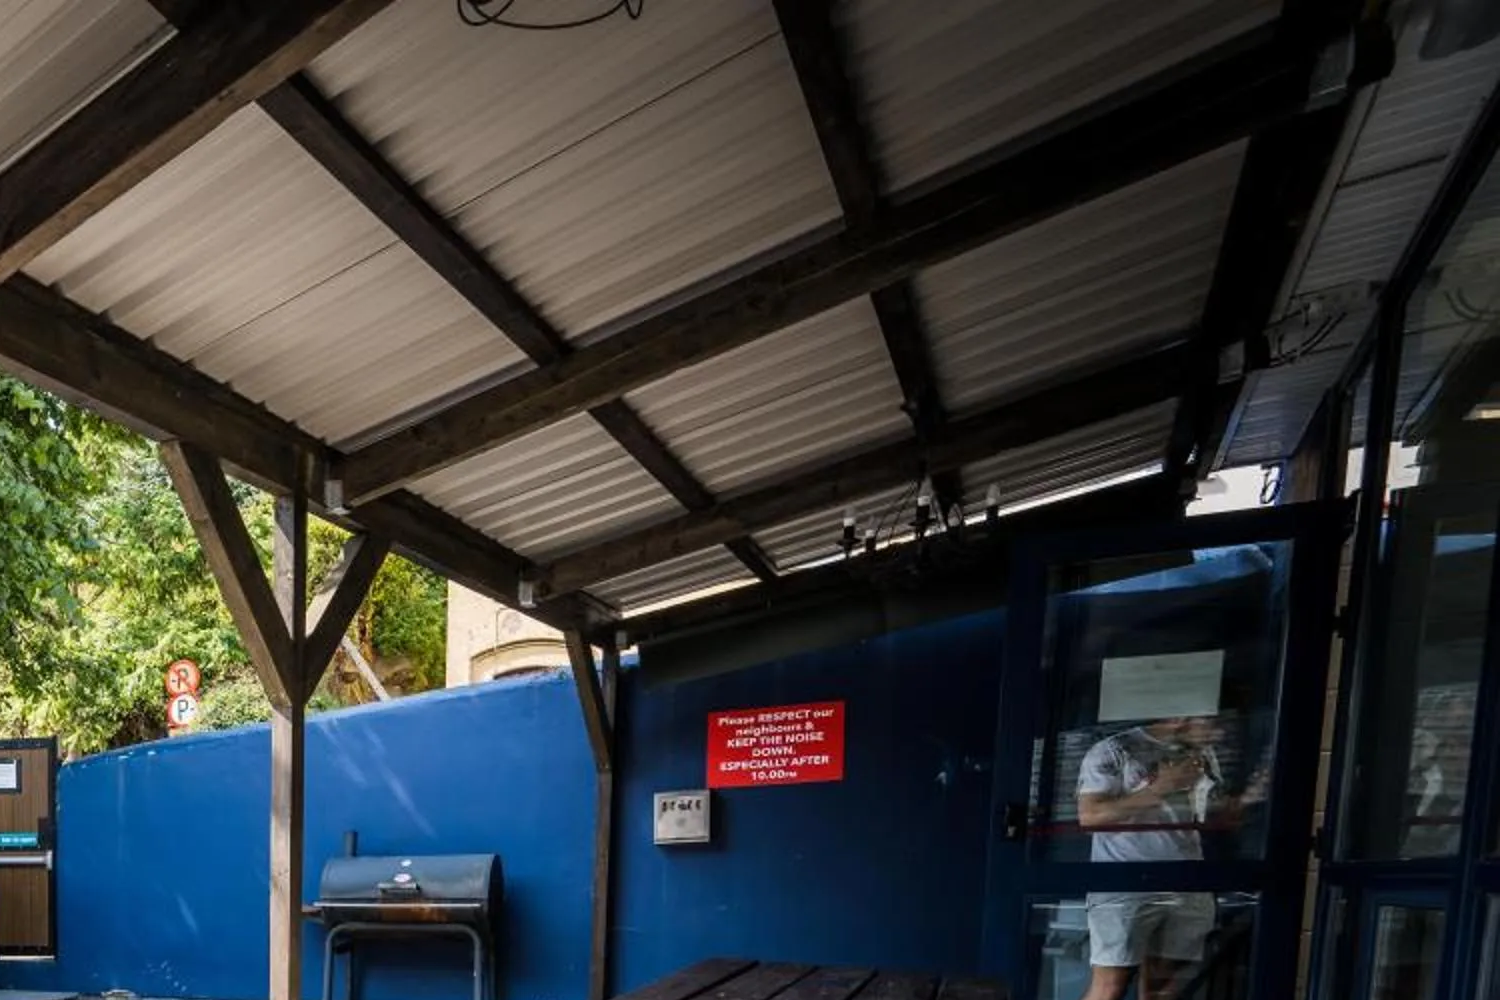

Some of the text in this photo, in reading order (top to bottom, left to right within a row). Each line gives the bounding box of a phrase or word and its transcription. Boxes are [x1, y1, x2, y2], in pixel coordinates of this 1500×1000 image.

[178, 699, 189, 721] P
[718, 709, 835, 727] Please RESPECT our
[736, 721, 815, 737] neighbours &
[727, 731, 825, 748] KEEP THE NOISE
[720, 755, 830, 771] ESPECIALLY AFTER
